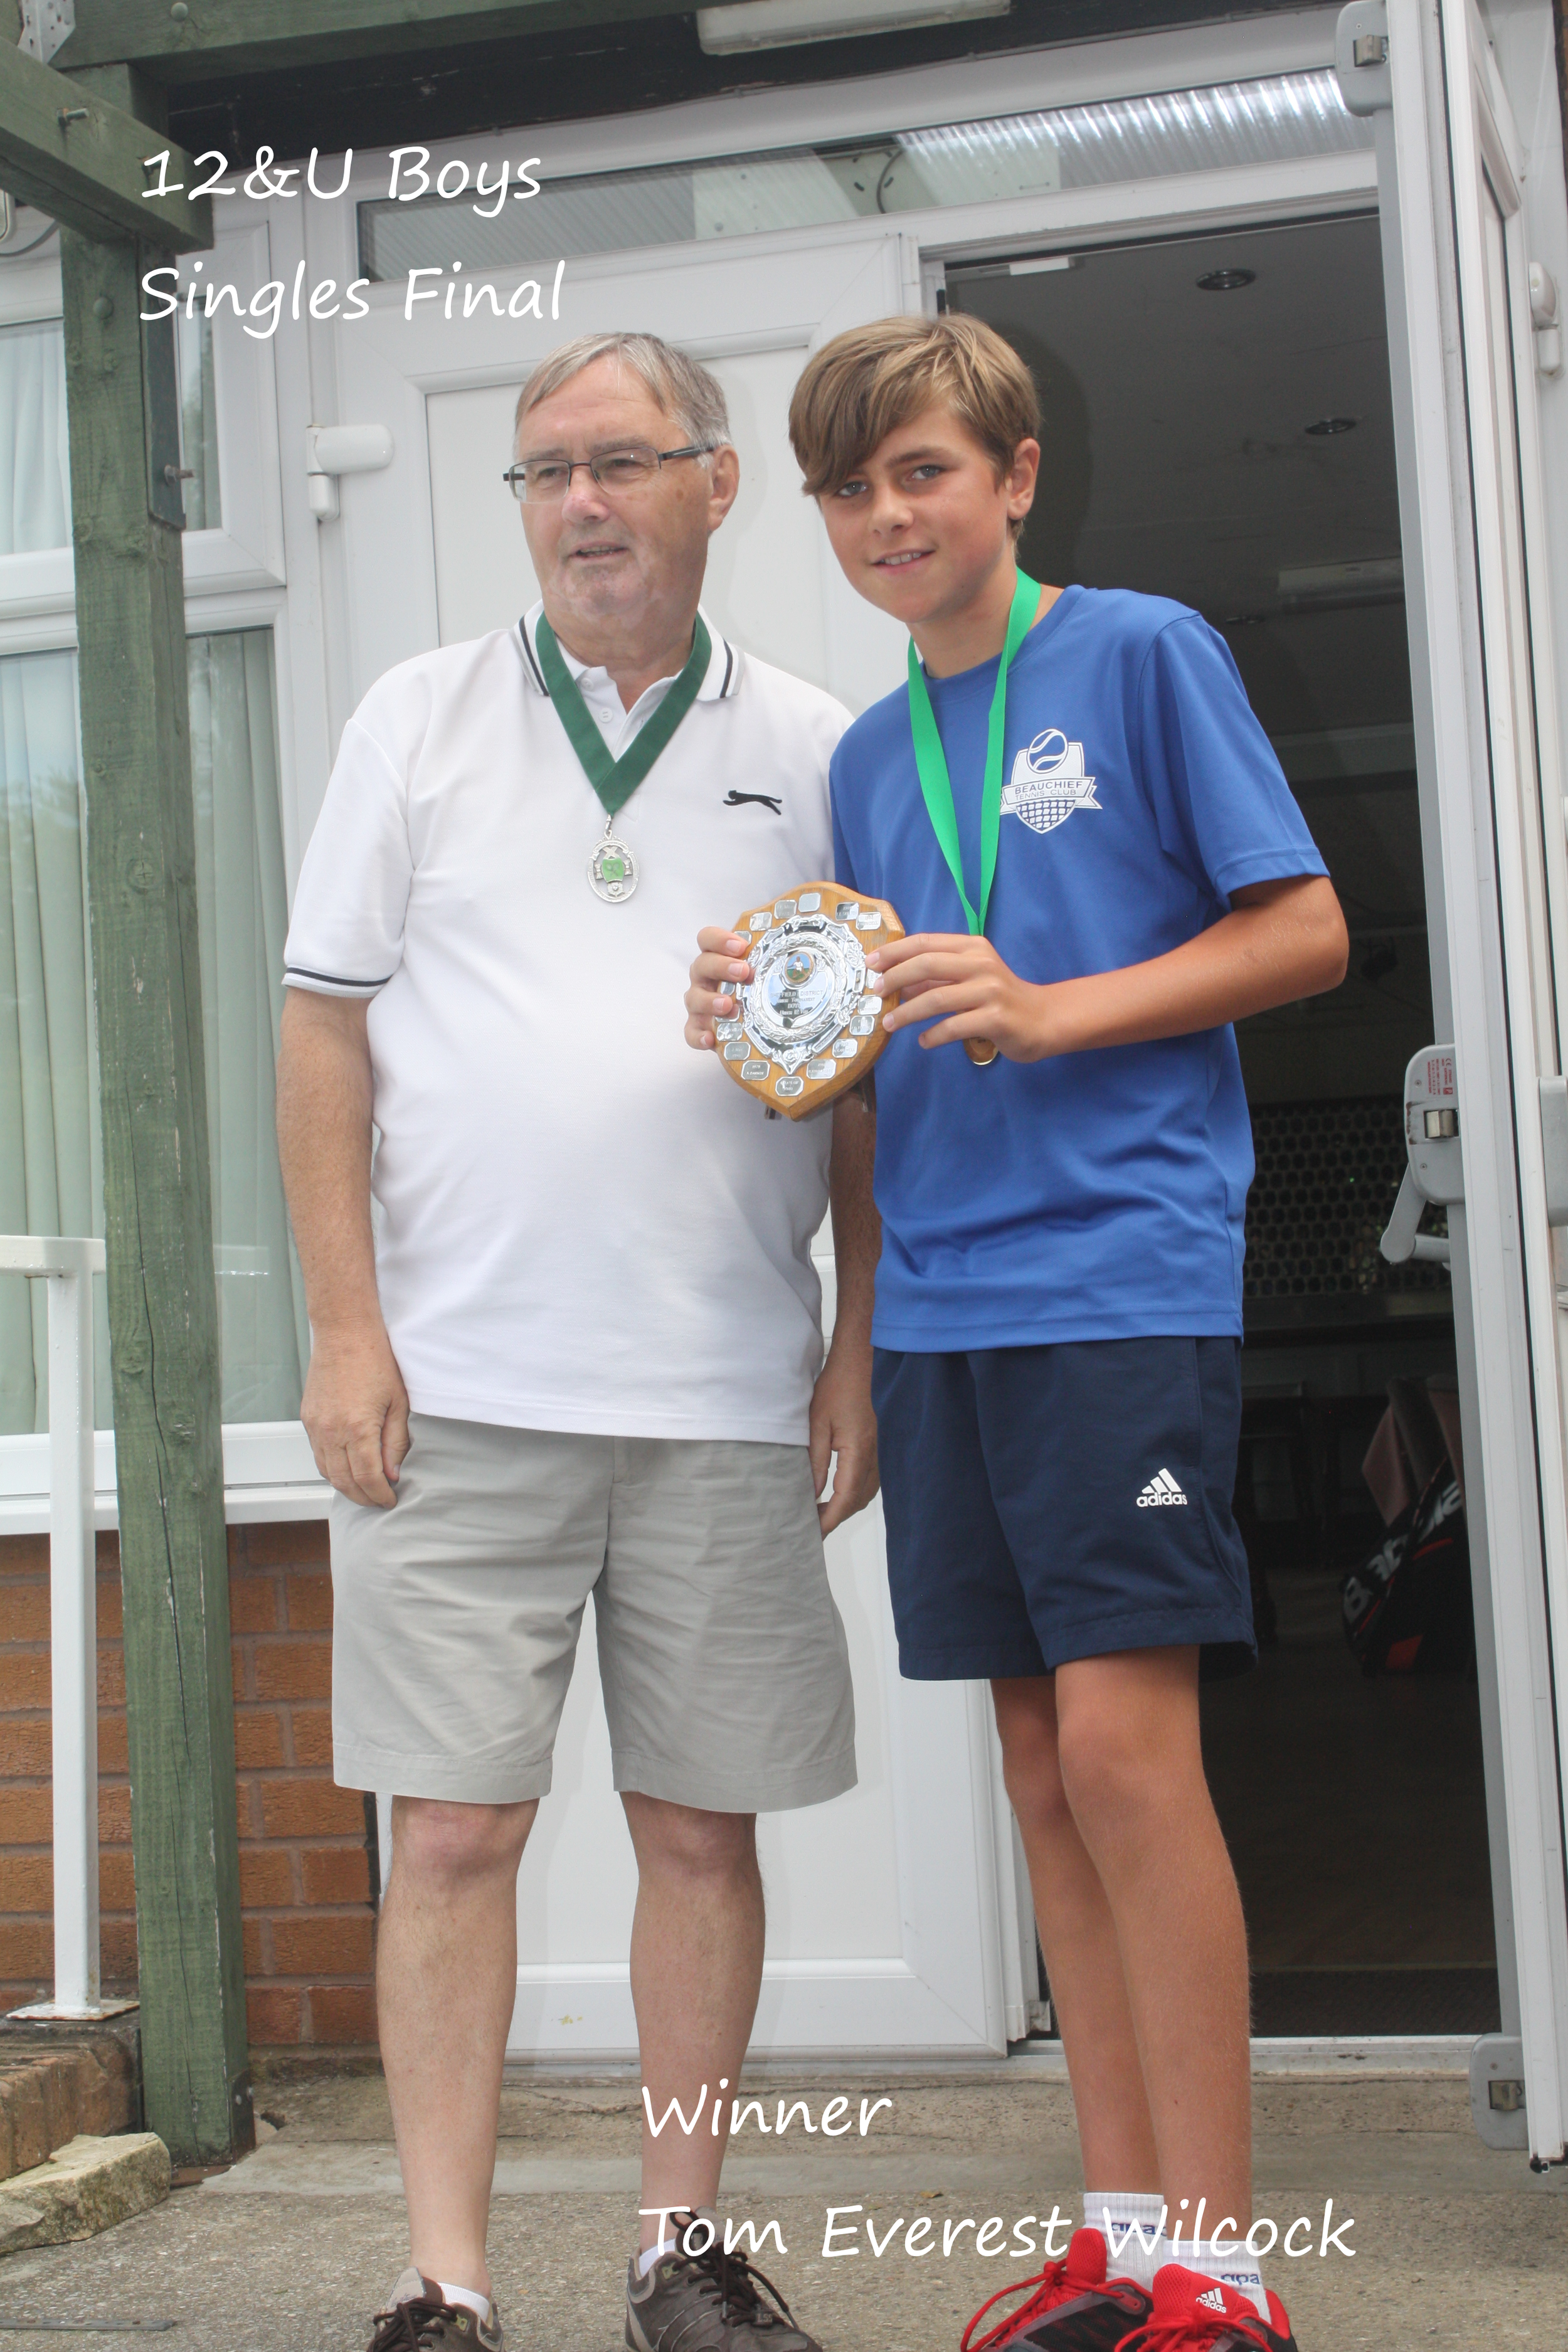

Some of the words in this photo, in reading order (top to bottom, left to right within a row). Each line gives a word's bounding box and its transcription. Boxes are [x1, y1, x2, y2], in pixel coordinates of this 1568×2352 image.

[1015, 781, 1083, 795] BEAUCHIEF
[1015, 790, 1044, 801] TENNIS
[1136, 1491, 1188, 1508] adidas
[1195, 2296, 1227, 2314] adidas
